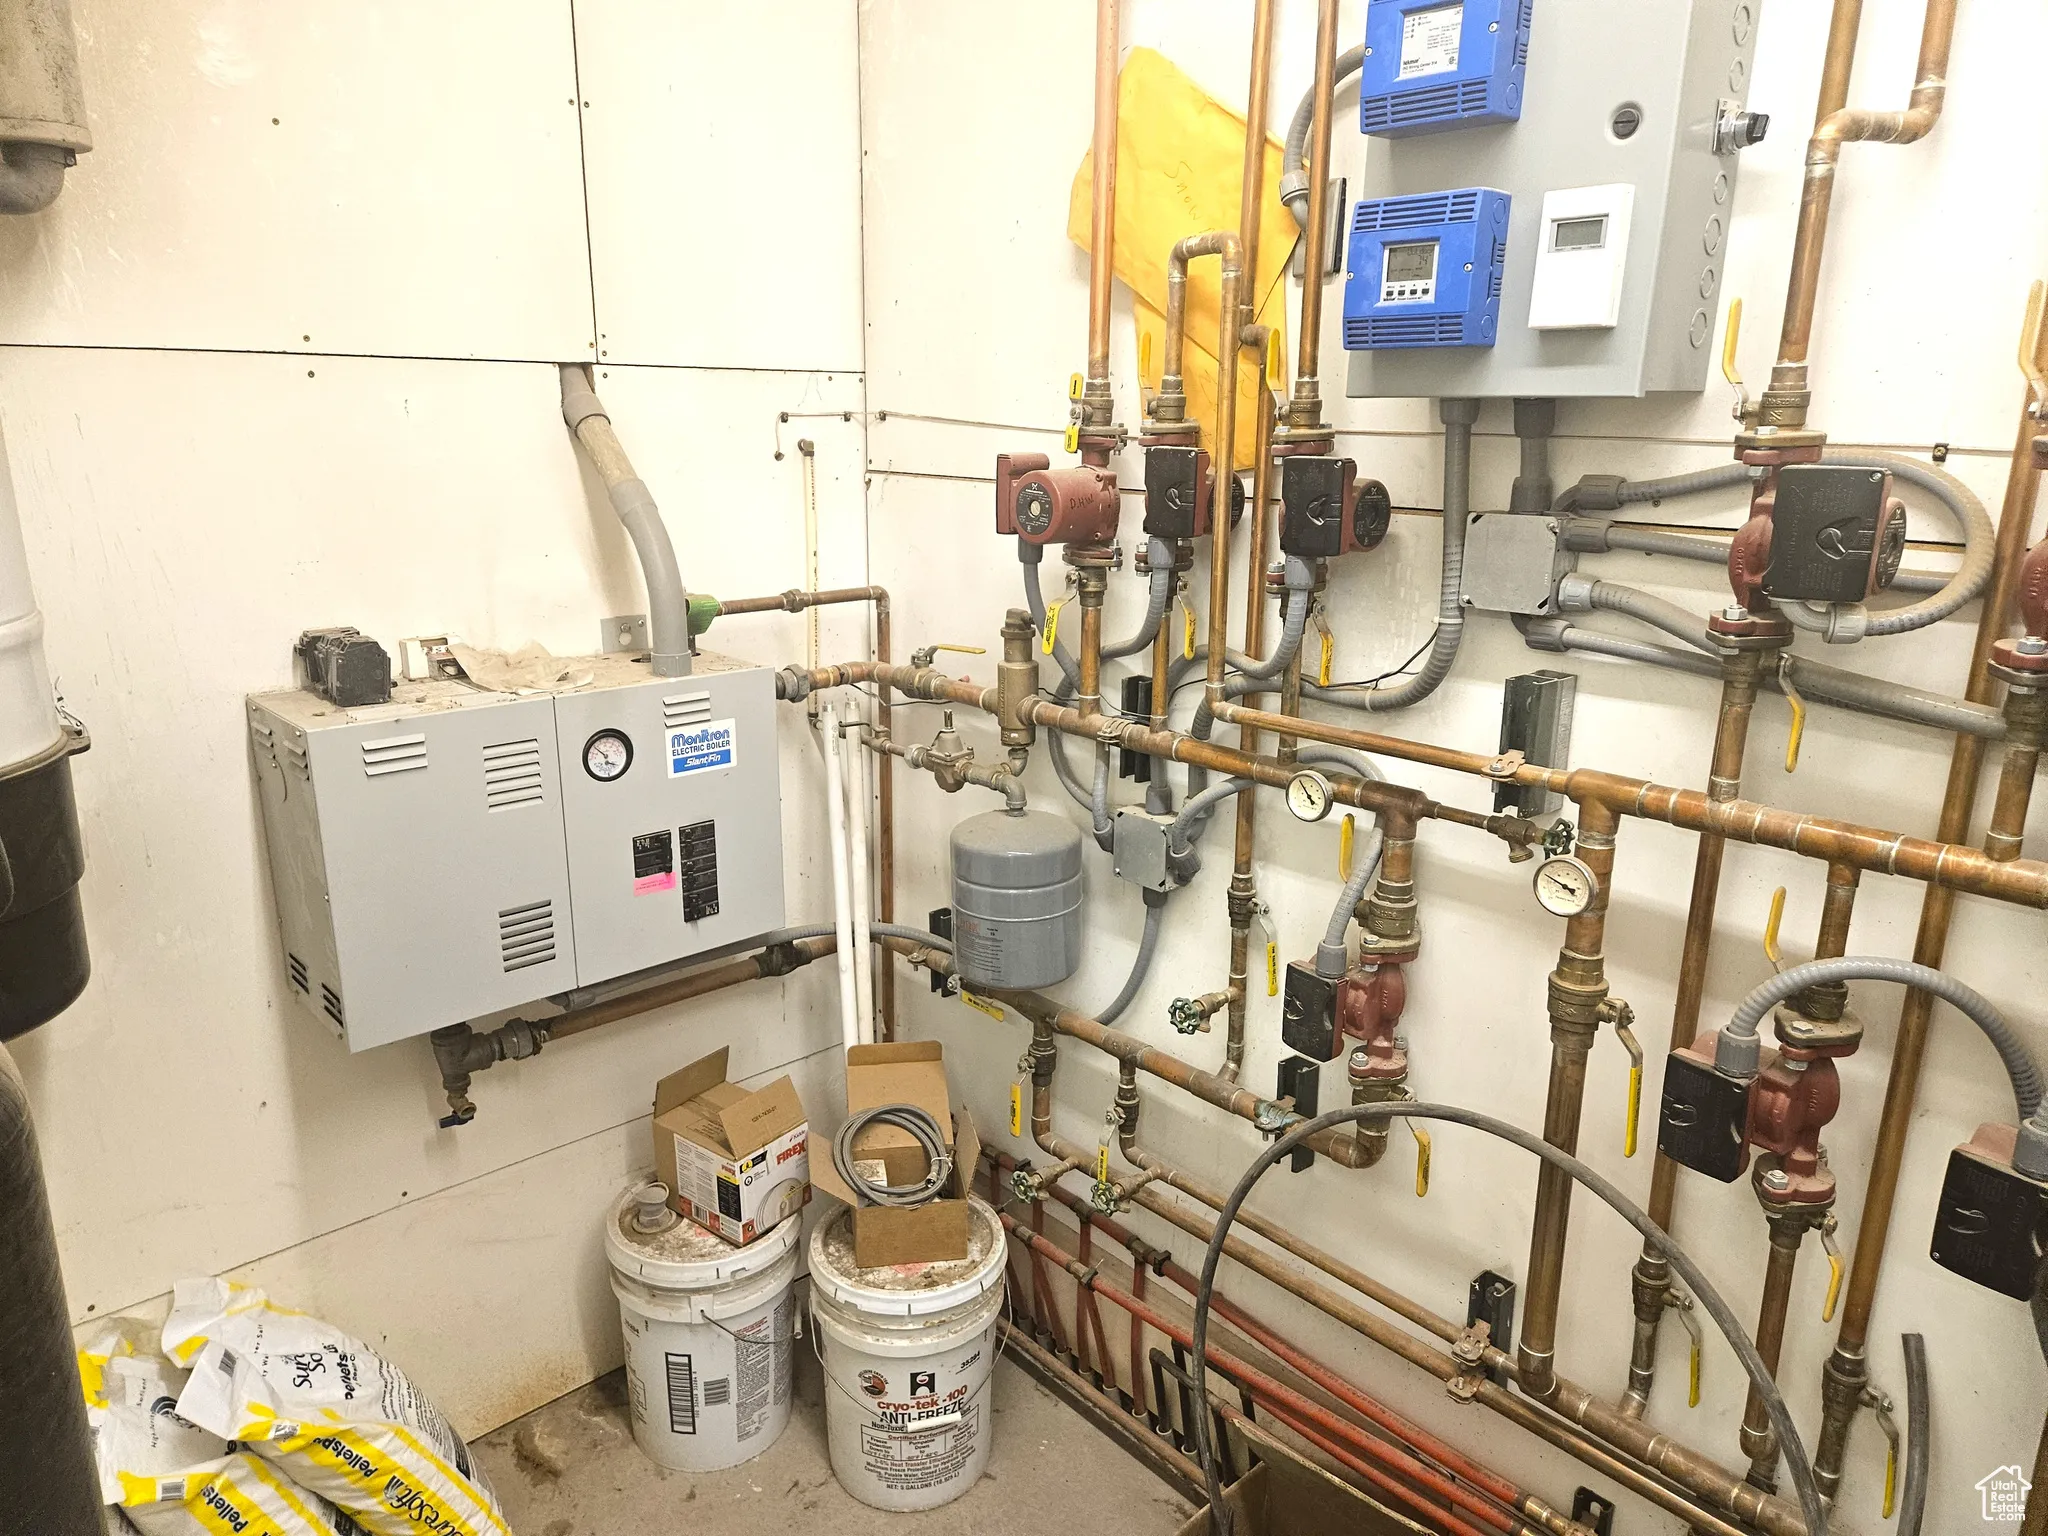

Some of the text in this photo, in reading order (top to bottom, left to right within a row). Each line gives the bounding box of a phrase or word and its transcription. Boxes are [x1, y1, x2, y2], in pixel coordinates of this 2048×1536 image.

[671, 739, 731, 757] ELECTRIC BOILER
[776, 1139, 807, 1165] FIREX
[877, 1398, 939, 1412] cryo-tek
[880, 1397, 965, 1424] ANTI-FREEZE
[871, 1420, 905, 1433] Non-Toxic
[329, 1438, 379, 1478] Pellets
[905, 1482, 932, 1490] GALLONS
[200, 1485, 249, 1534] Pellets
